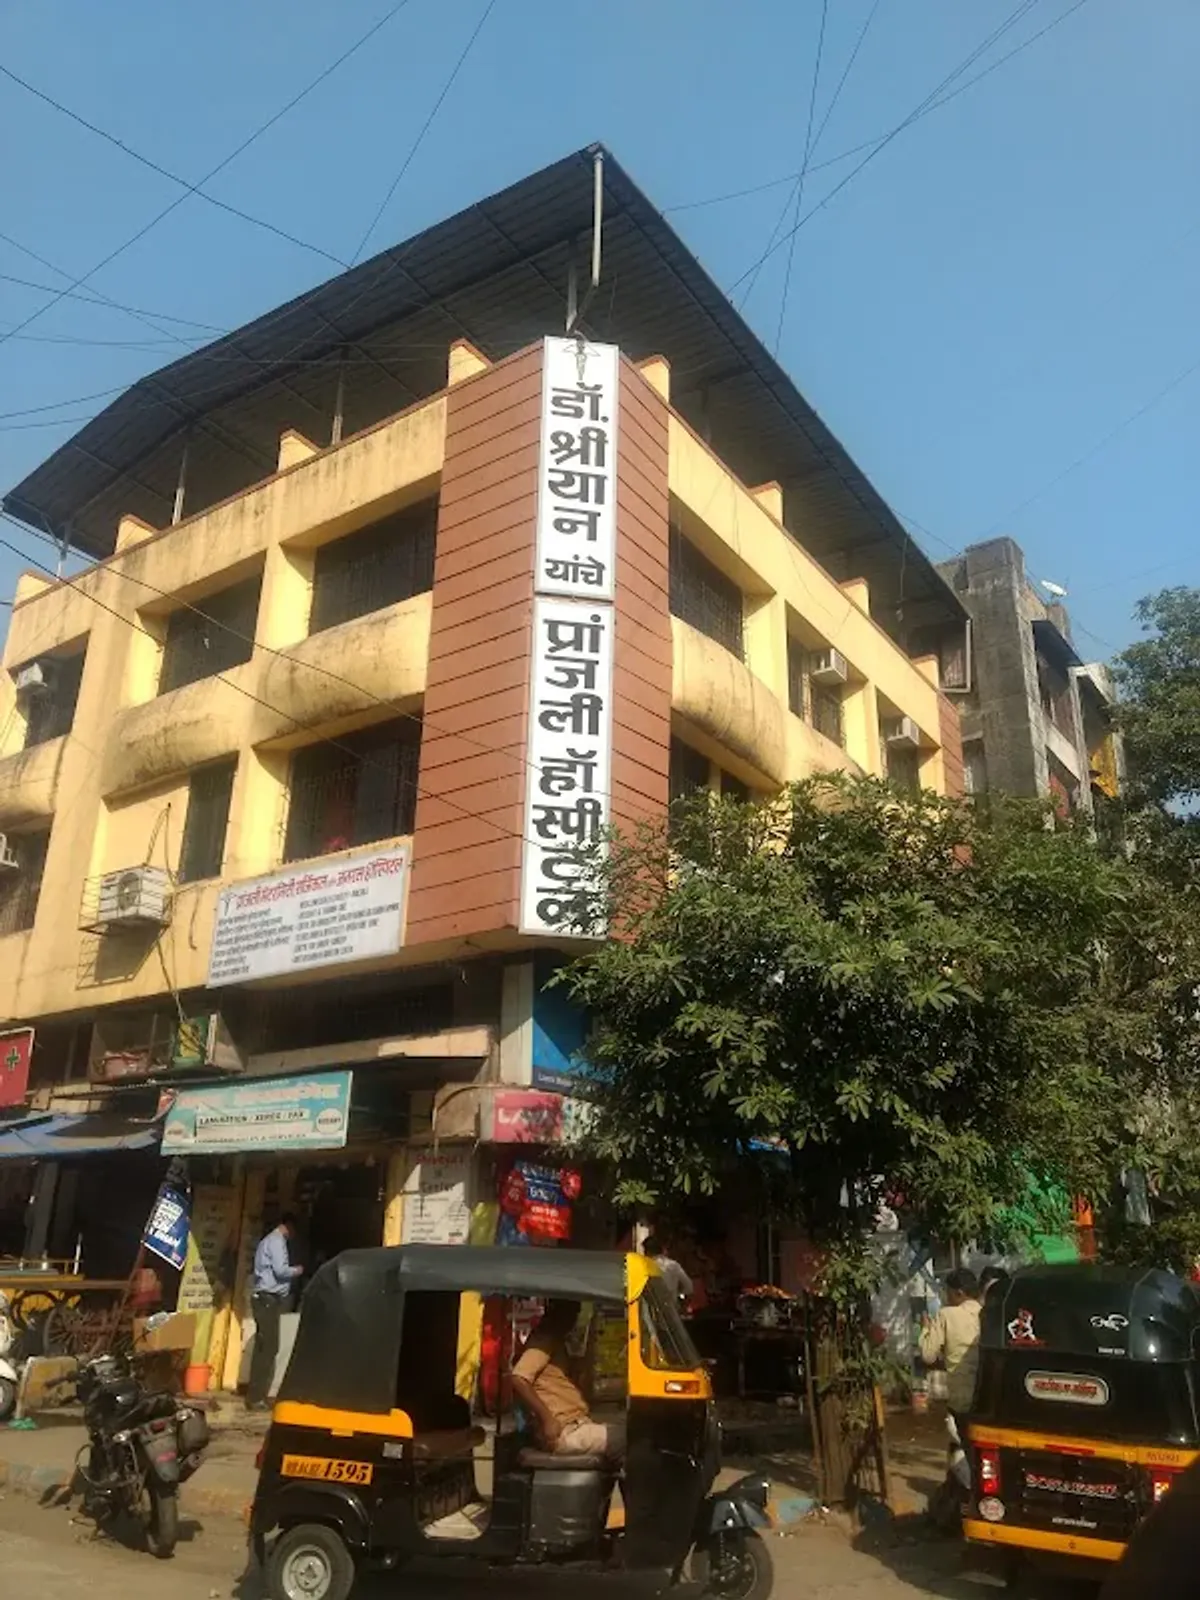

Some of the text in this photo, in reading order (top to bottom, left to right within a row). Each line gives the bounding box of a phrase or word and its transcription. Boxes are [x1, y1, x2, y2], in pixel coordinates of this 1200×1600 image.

[551, 381, 609, 423] डॉ.
[544, 555, 606, 586] यांचे
[538, 614, 606, 736] प्रांजली
